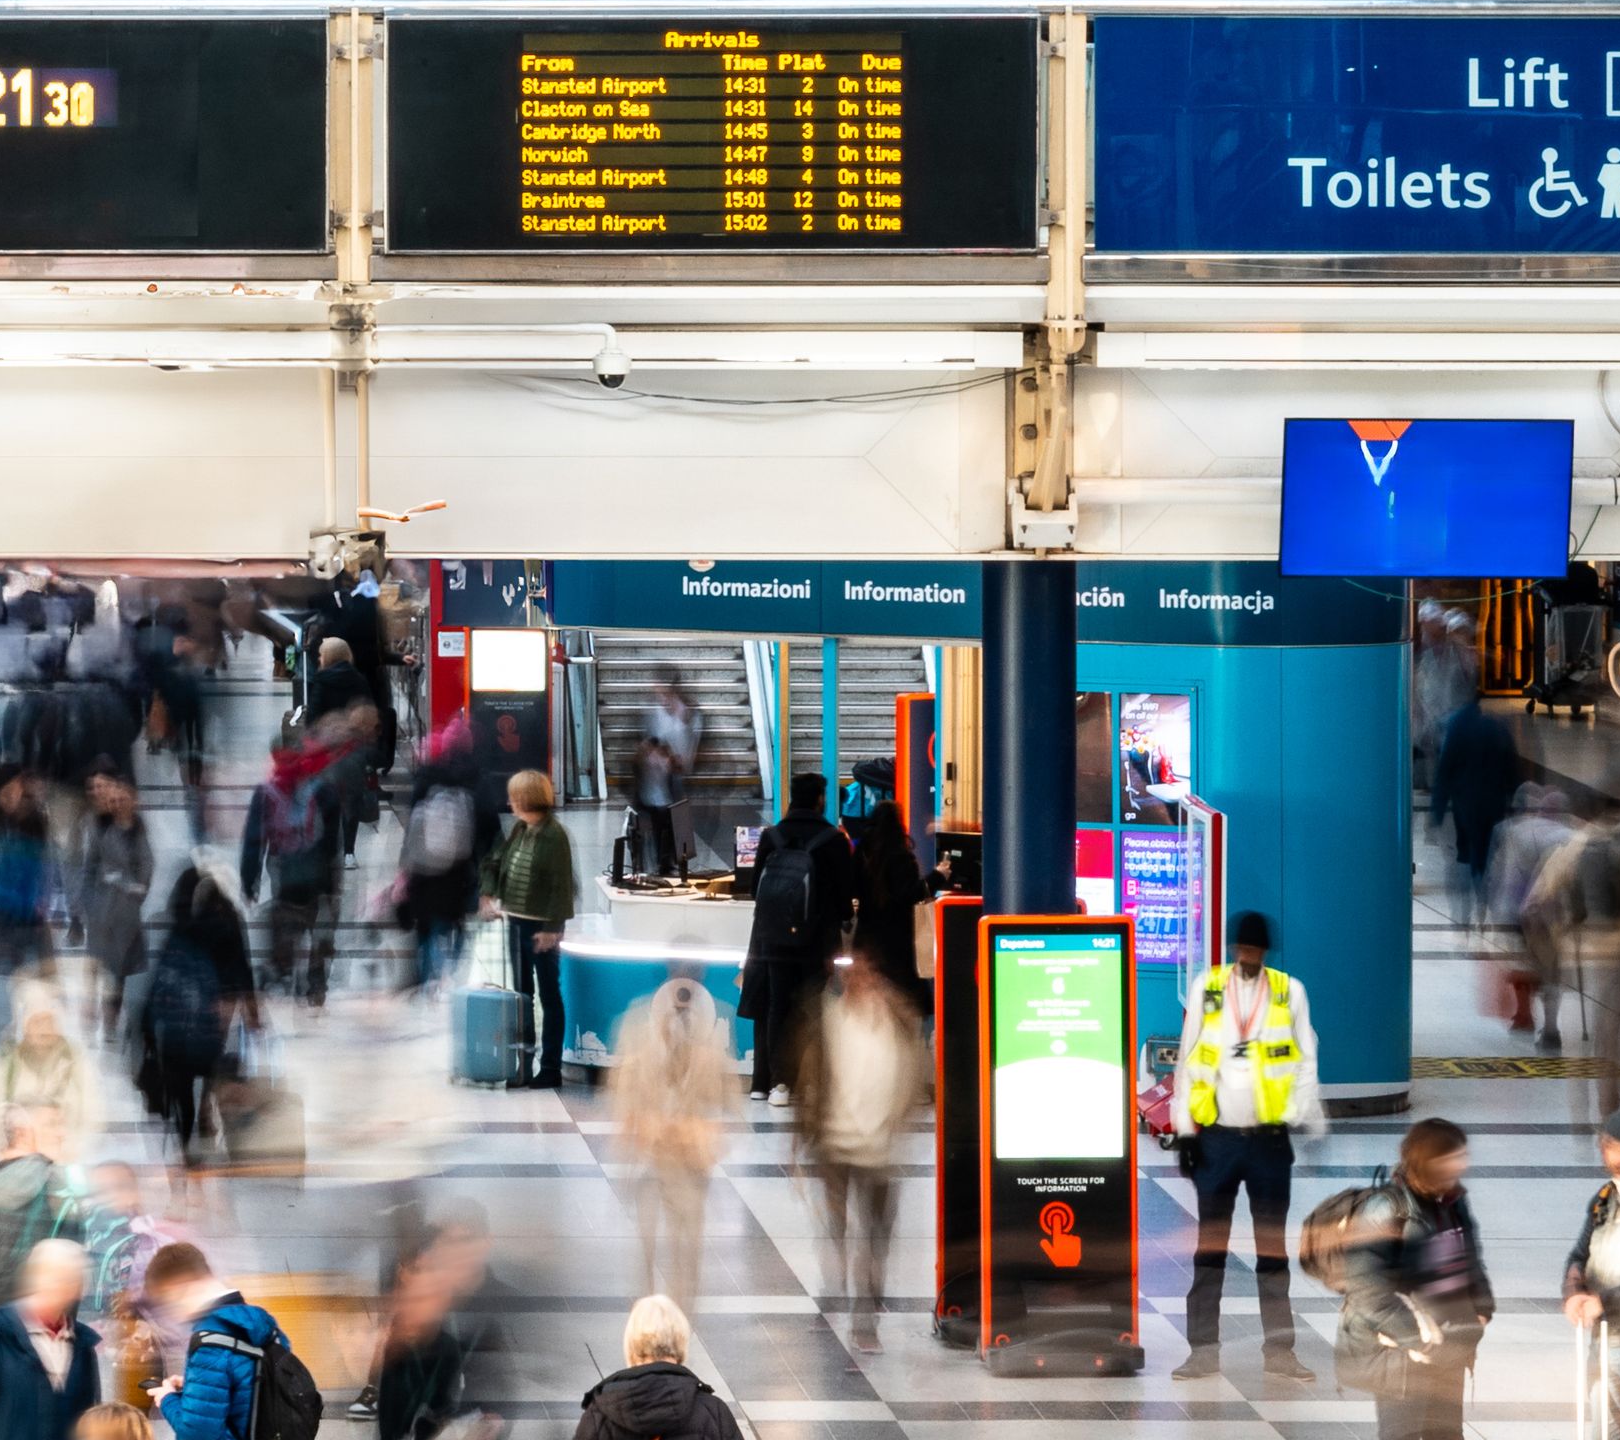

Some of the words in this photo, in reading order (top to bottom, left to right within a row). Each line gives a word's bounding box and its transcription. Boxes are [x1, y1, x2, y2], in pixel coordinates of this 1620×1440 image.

[664, 31, 760, 49] Arrivals
[521, 54, 575, 72] From
[721, 53, 768, 71] Time
[778, 53, 827, 71] Plat
[861, 53, 902, 71] Due
[521, 77, 597, 95] Stansted
[601, 77, 667, 97] Airport
[724, 76, 767, 94] 14:31
[802, 76, 814, 94] 2
[838, 76, 860, 94] On
[864, 76, 902, 94] time
[1468, 57, 1569, 109] Lift
[521, 100, 587, 118] Clacton
[592, 103, 614, 117] on
[619, 99, 651, 117] Sea
[724, 99, 767, 117] 14:31
[794, 99, 814, 117] 14
[837, 99, 860, 117] On
[865, 99, 902, 116] time
[1287, 156, 1491, 209] Toilets
[682, 575, 811, 599] Informazioni
[844, 580, 966, 604] Information
[1159, 588, 1274, 615] Informacja
[1016, 1177, 1043, 1186] TOUCH
[1043, 1177, 1058, 1185] THE
[1059, 1177, 1089, 1185] SCREEN
[1089, 1177, 1105, 1185] FOR
[1034, 1184, 1087, 1193] INFORMATION
